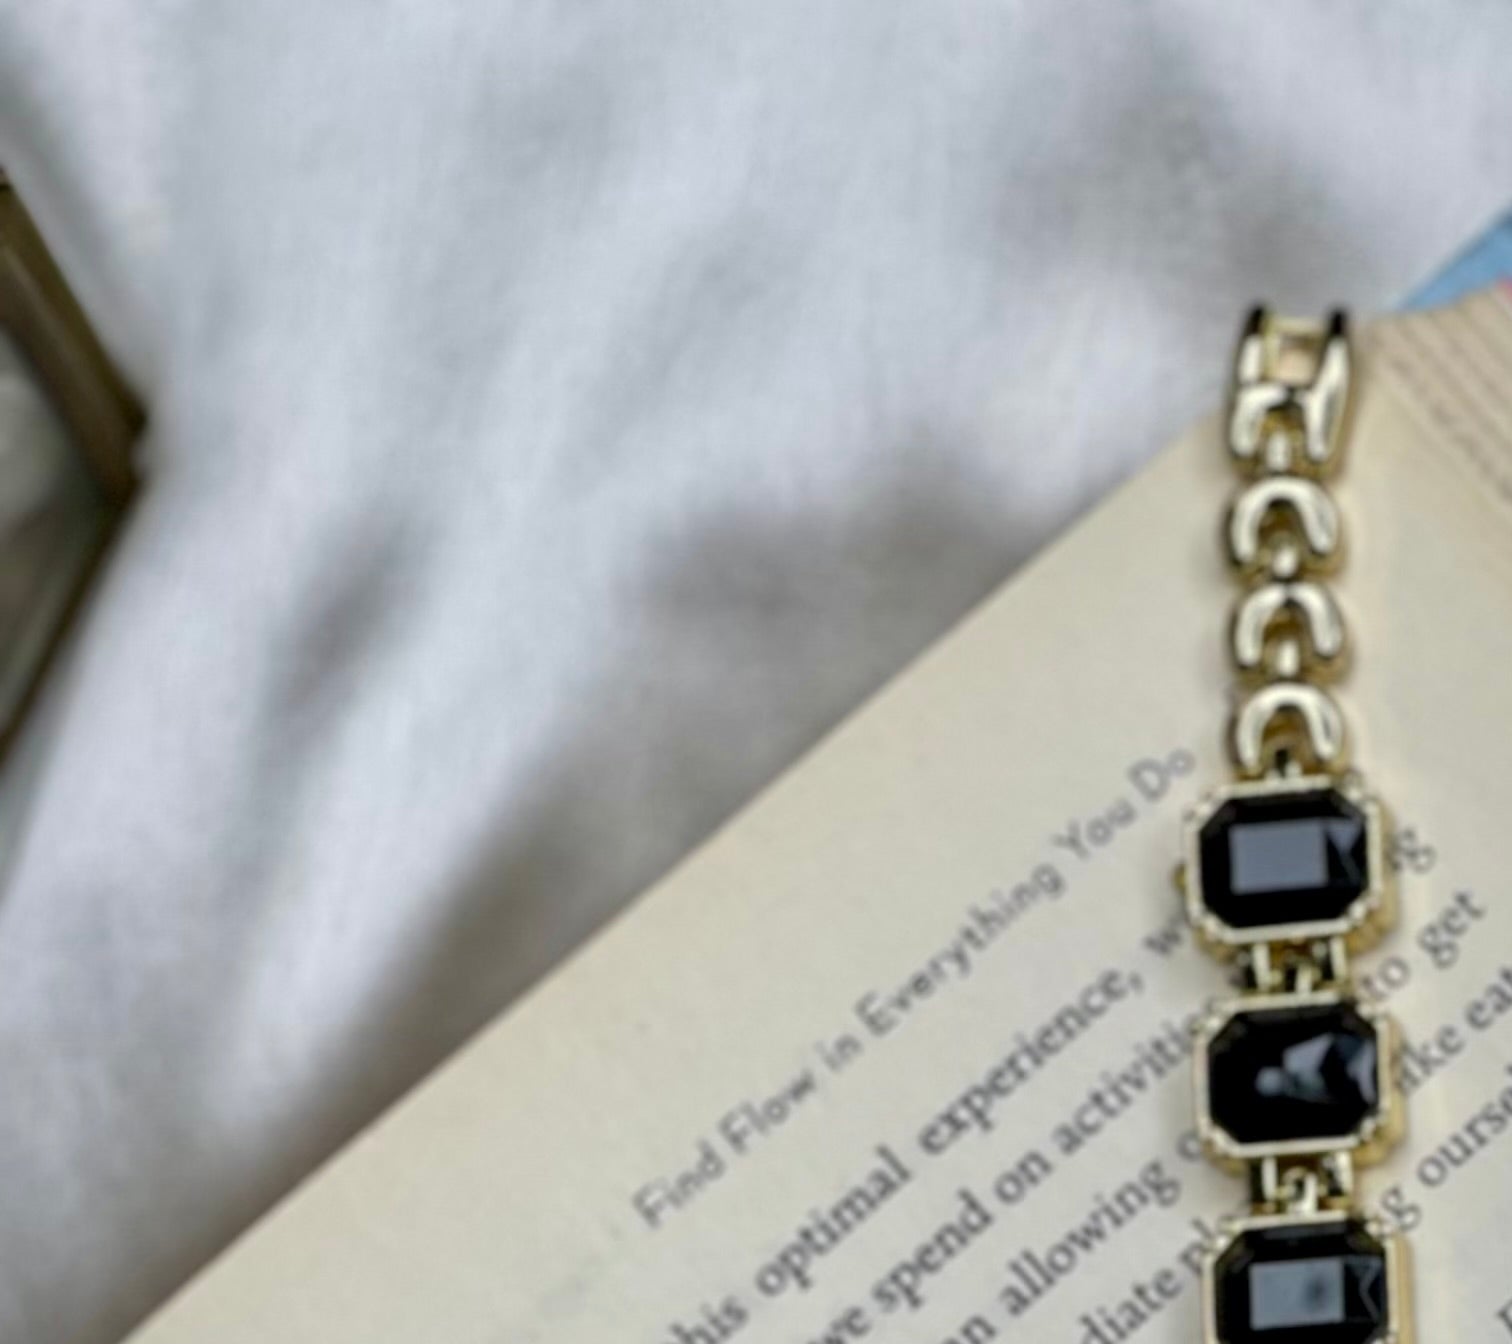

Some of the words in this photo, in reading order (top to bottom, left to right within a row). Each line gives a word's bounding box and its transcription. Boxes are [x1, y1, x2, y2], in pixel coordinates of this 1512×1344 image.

[631, 1139, 727, 1229] Find
[718, 1069, 817, 1154] Flow
[816, 1033, 864, 1072] in
[854, 863, 1066, 1037] Everything
[1051, 798, 1138, 860] You
[1126, 748, 1199, 803] Do
[755, 1144, 913, 1297] optimal
[917, 969, 1143, 1155] experience,
